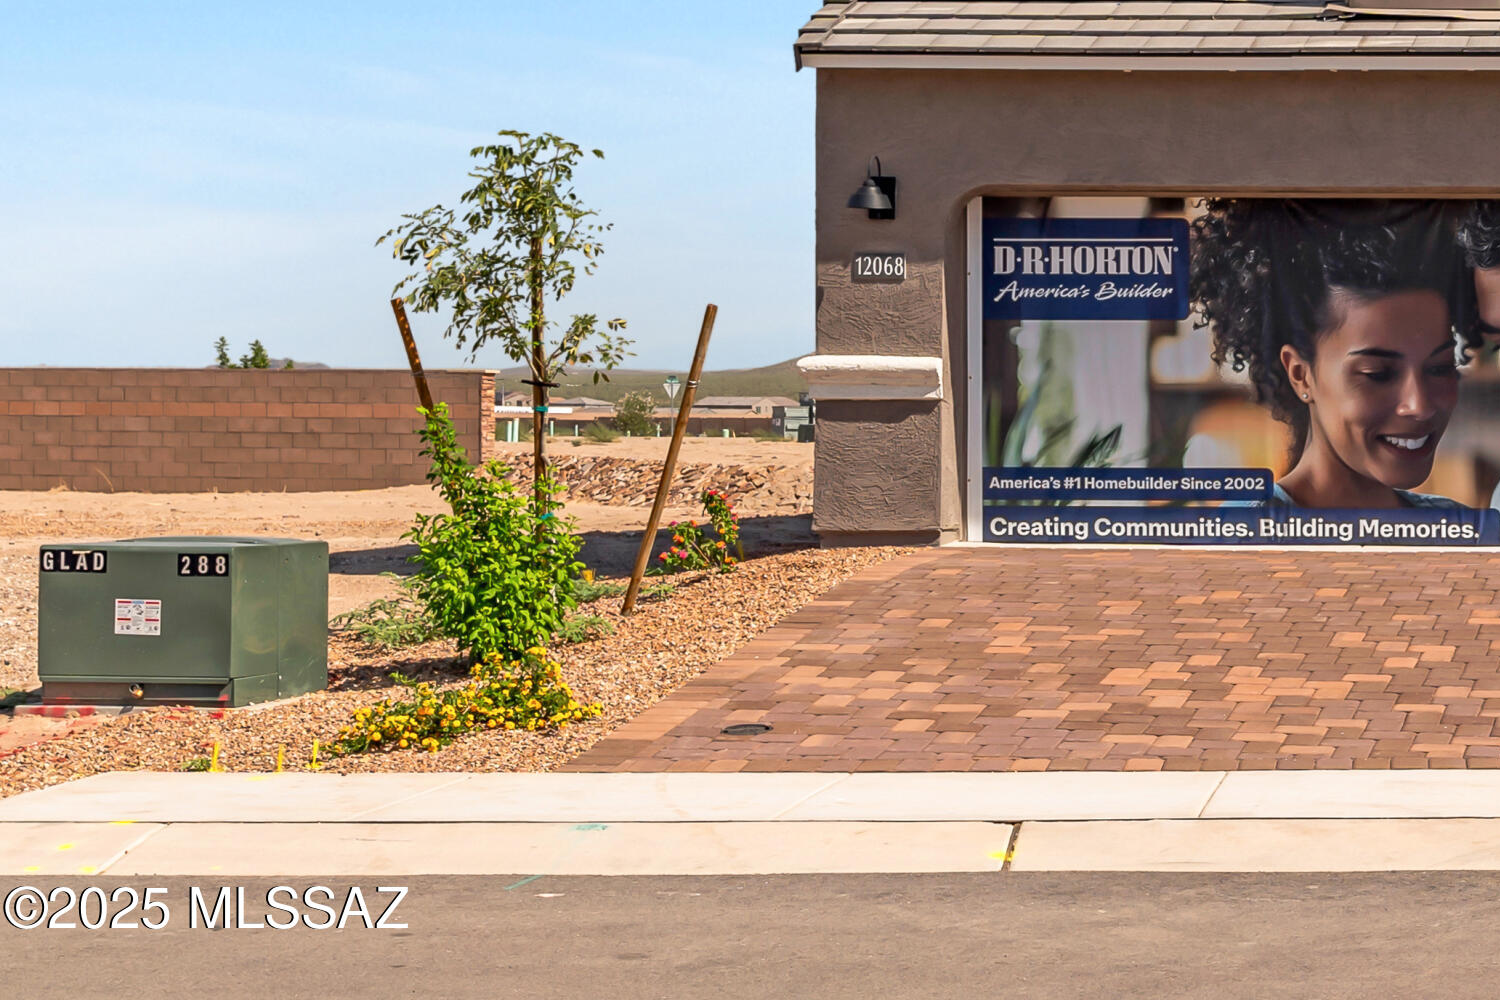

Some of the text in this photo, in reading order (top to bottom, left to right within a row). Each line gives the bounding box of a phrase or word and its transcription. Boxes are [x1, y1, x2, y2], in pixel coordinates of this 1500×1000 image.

[855, 256, 904, 276] 12068
[993, 280, 1174, 302] America's Builder
[989, 476, 1265, 491] America's #1 Homebuilder Since 2002
[989, 517, 1480, 541] Creating Communities. Building Memories.
[43, 551, 226, 575] GLAD 288
